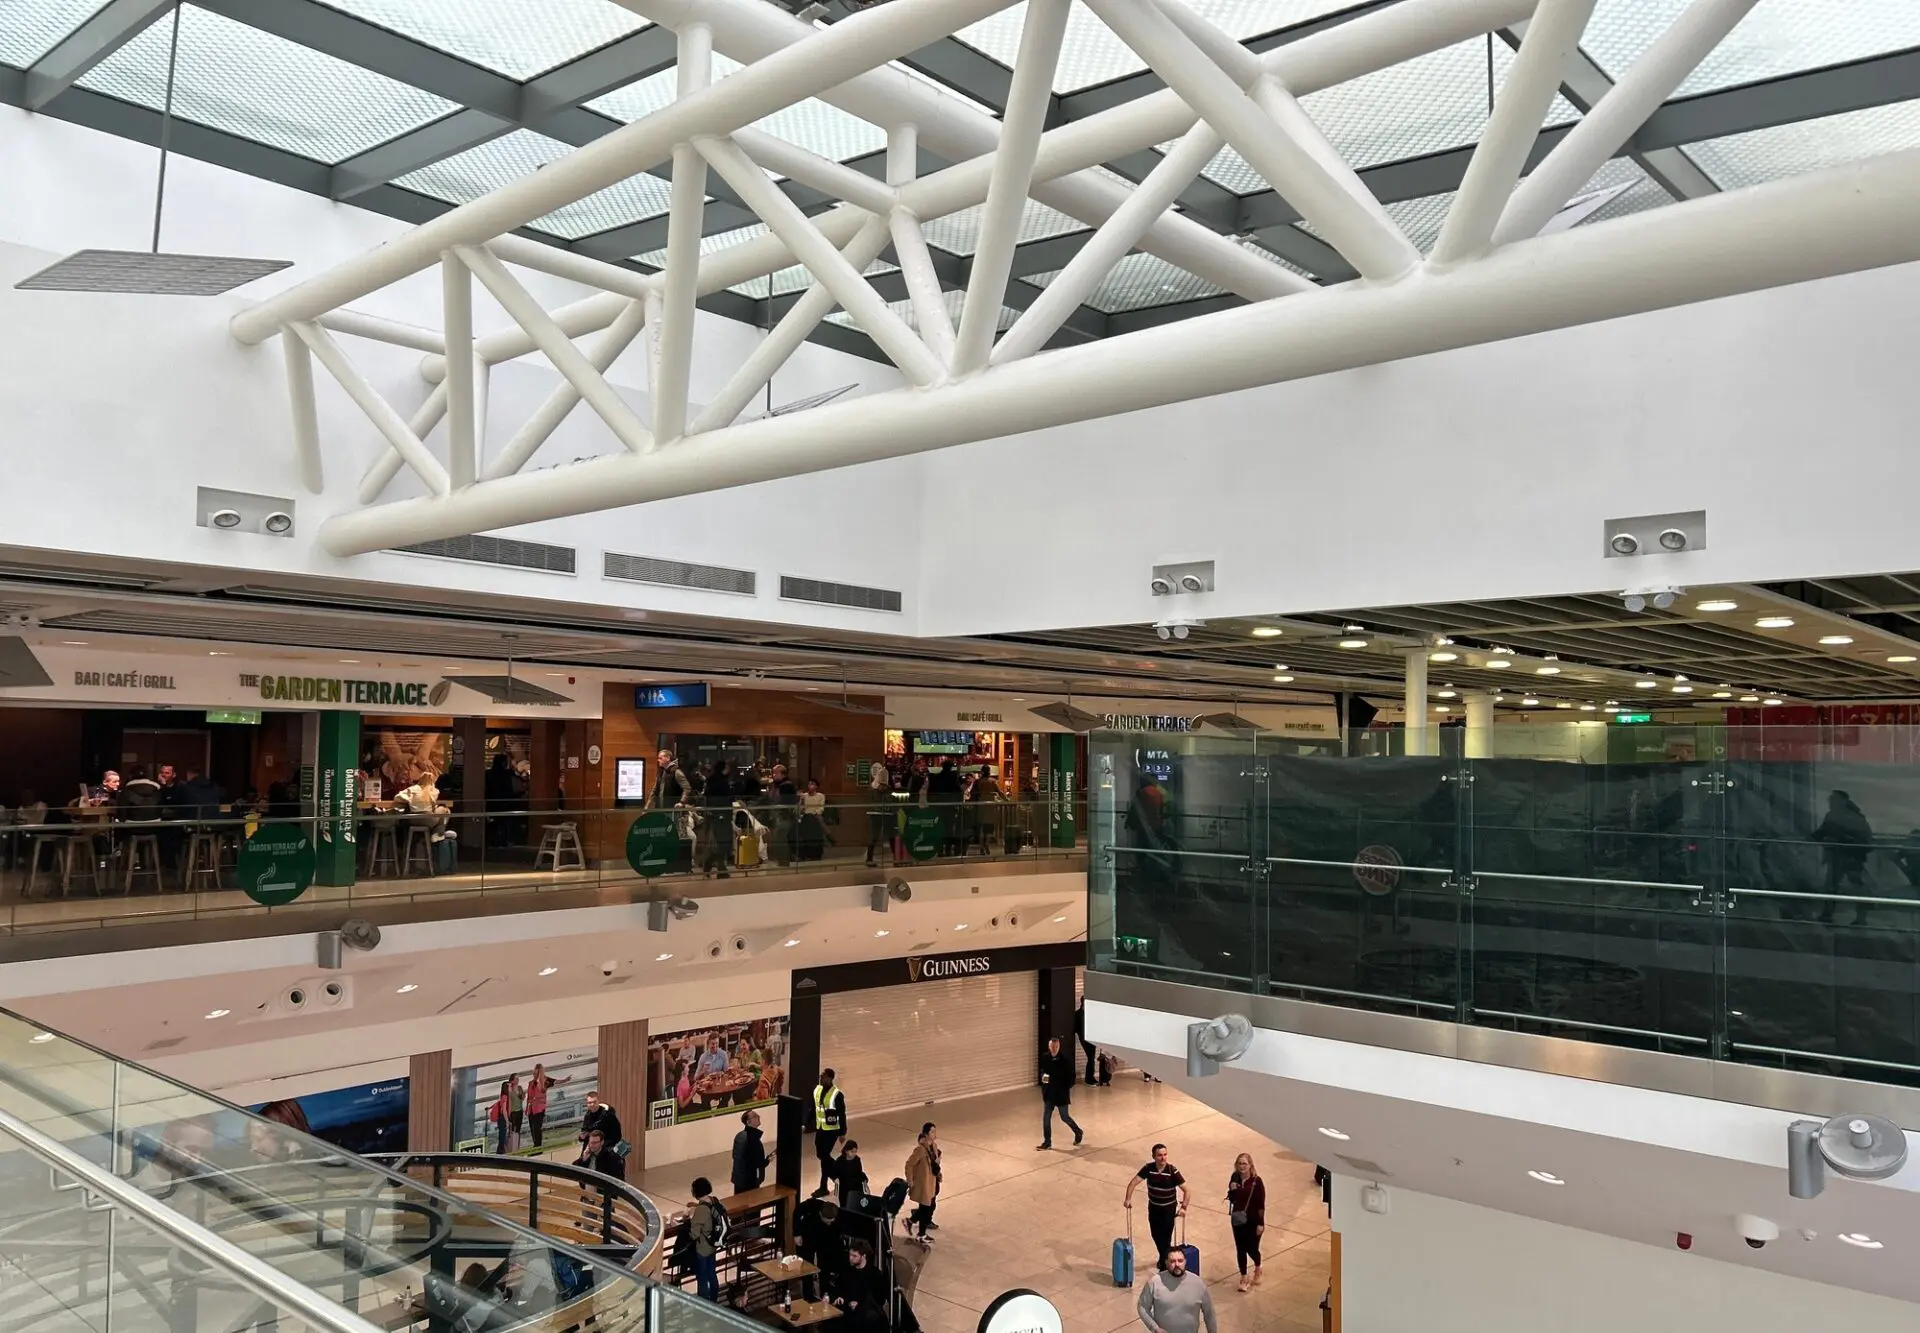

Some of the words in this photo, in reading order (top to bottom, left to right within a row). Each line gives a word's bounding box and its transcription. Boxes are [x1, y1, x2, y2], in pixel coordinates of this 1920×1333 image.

[74, 671, 101, 686] BAR
[107, 670, 137, 688] CAFÉ
[143, 675, 176, 690] GRILL
[239, 674, 259, 688] THE
[260, 675, 341, 702] GARDEN
[343, 680, 428, 706] TERRACE
[923, 956, 990, 977] GUINNESS
[655, 1107, 672, 1117] DUB
